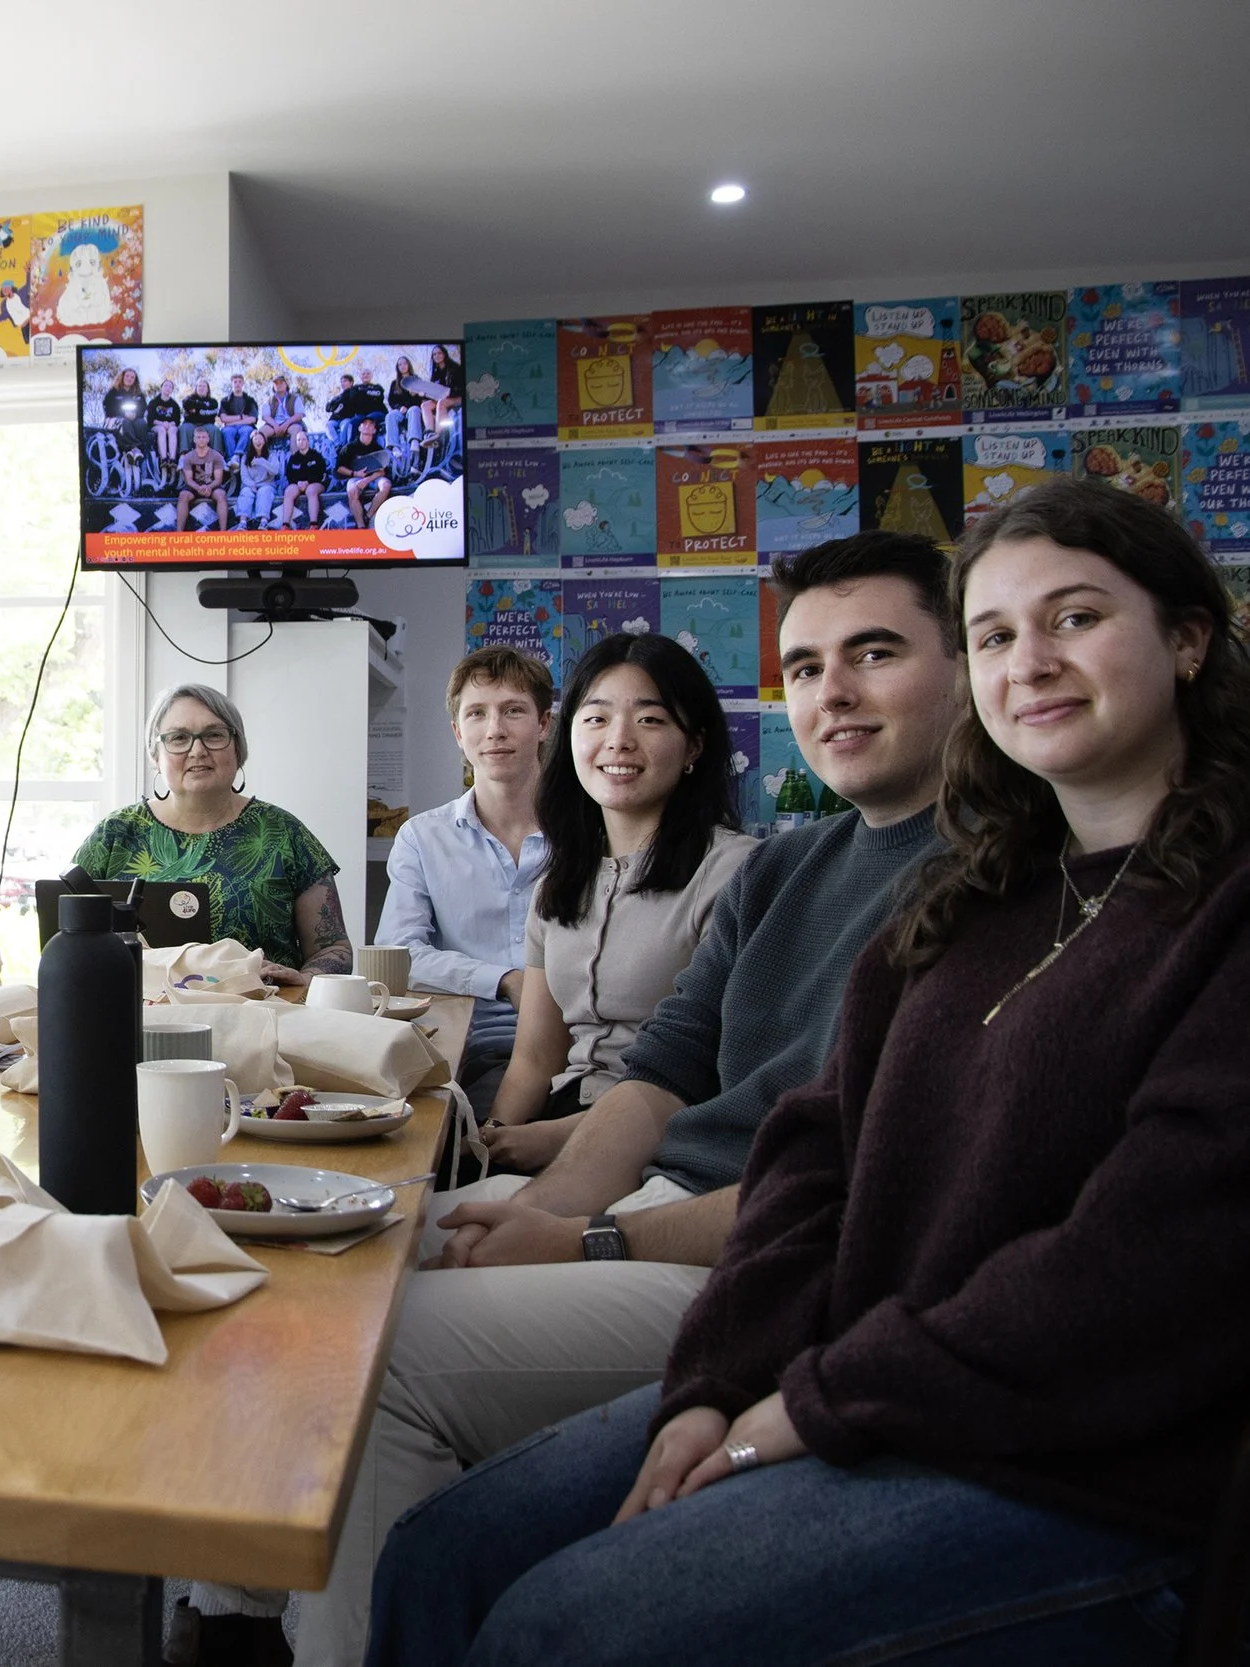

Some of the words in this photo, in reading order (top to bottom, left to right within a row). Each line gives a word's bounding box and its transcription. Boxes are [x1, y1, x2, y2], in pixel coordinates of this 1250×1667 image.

[57, 219, 75, 234] BE
[81, 214, 110, 230] KIND
[40, 238, 54, 251] TO
[98, 223, 129, 241] MIND
[1197, 291, 1220, 302] WHEN
[961, 294, 1017, 321] SPEAK
[1021, 291, 1066, 323] KIND
[871, 310, 908, 323] LISTEN
[912, 309, 926, 318] UP
[873, 321, 907, 330] STAND
[910, 319, 924, 328] UP
[1103, 318, 1142, 331] WE'RE
[1095, 332, 1151, 346] PERFECT
[1088, 347, 1120, 360] EVEN
[1126, 345, 1158, 358] WITH
[1085, 364, 1110, 374] OUR
[1114, 358, 1164, 371] THORNS
[582, 407, 644, 425] PROTECT
[980, 441, 1019, 451] LISTEN
[1022, 440, 1037, 448] UP
[1071, 428, 1130, 454] SPEAK
[1132, 427, 1179, 456] KIND
[983, 451, 1018, 461] STAND
[1021, 450, 1035, 459] UP
[1219, 454, 1250, 467] WE'R
[478, 461, 498, 469] WHEN
[500, 459, 522, 467] YOU'RE
[525, 459, 539, 467] LOW
[1210, 468, 1250, 481] PERFE
[1203, 484, 1236, 496] EVEN
[1199, 498, 1225, 509] OUR
[104, 535, 166, 546] Empowering
[169, 534, 192, 544] rural
[195, 533, 258, 544] communities
[261, 534, 270, 543] to
[275, 532, 315, 545] improve
[684, 535, 747, 552] PROTECT
[104, 548, 132, 560] youth
[135, 547, 170, 557] mental
[173, 546, 203, 557] health
[207, 546, 225, 556] and
[228, 545, 262, 556] reduce
[265, 545, 299, 555] suicide
[319, 546, 387, 556] www.live4life.org.au
[577, 591, 597, 600] WHEN
[599, 591, 622, 599] YOU'RE
[624, 591, 639, 599] LOW
[496, 611, 530, 623] WE'RE
[489, 624, 537, 636] PERFECT
